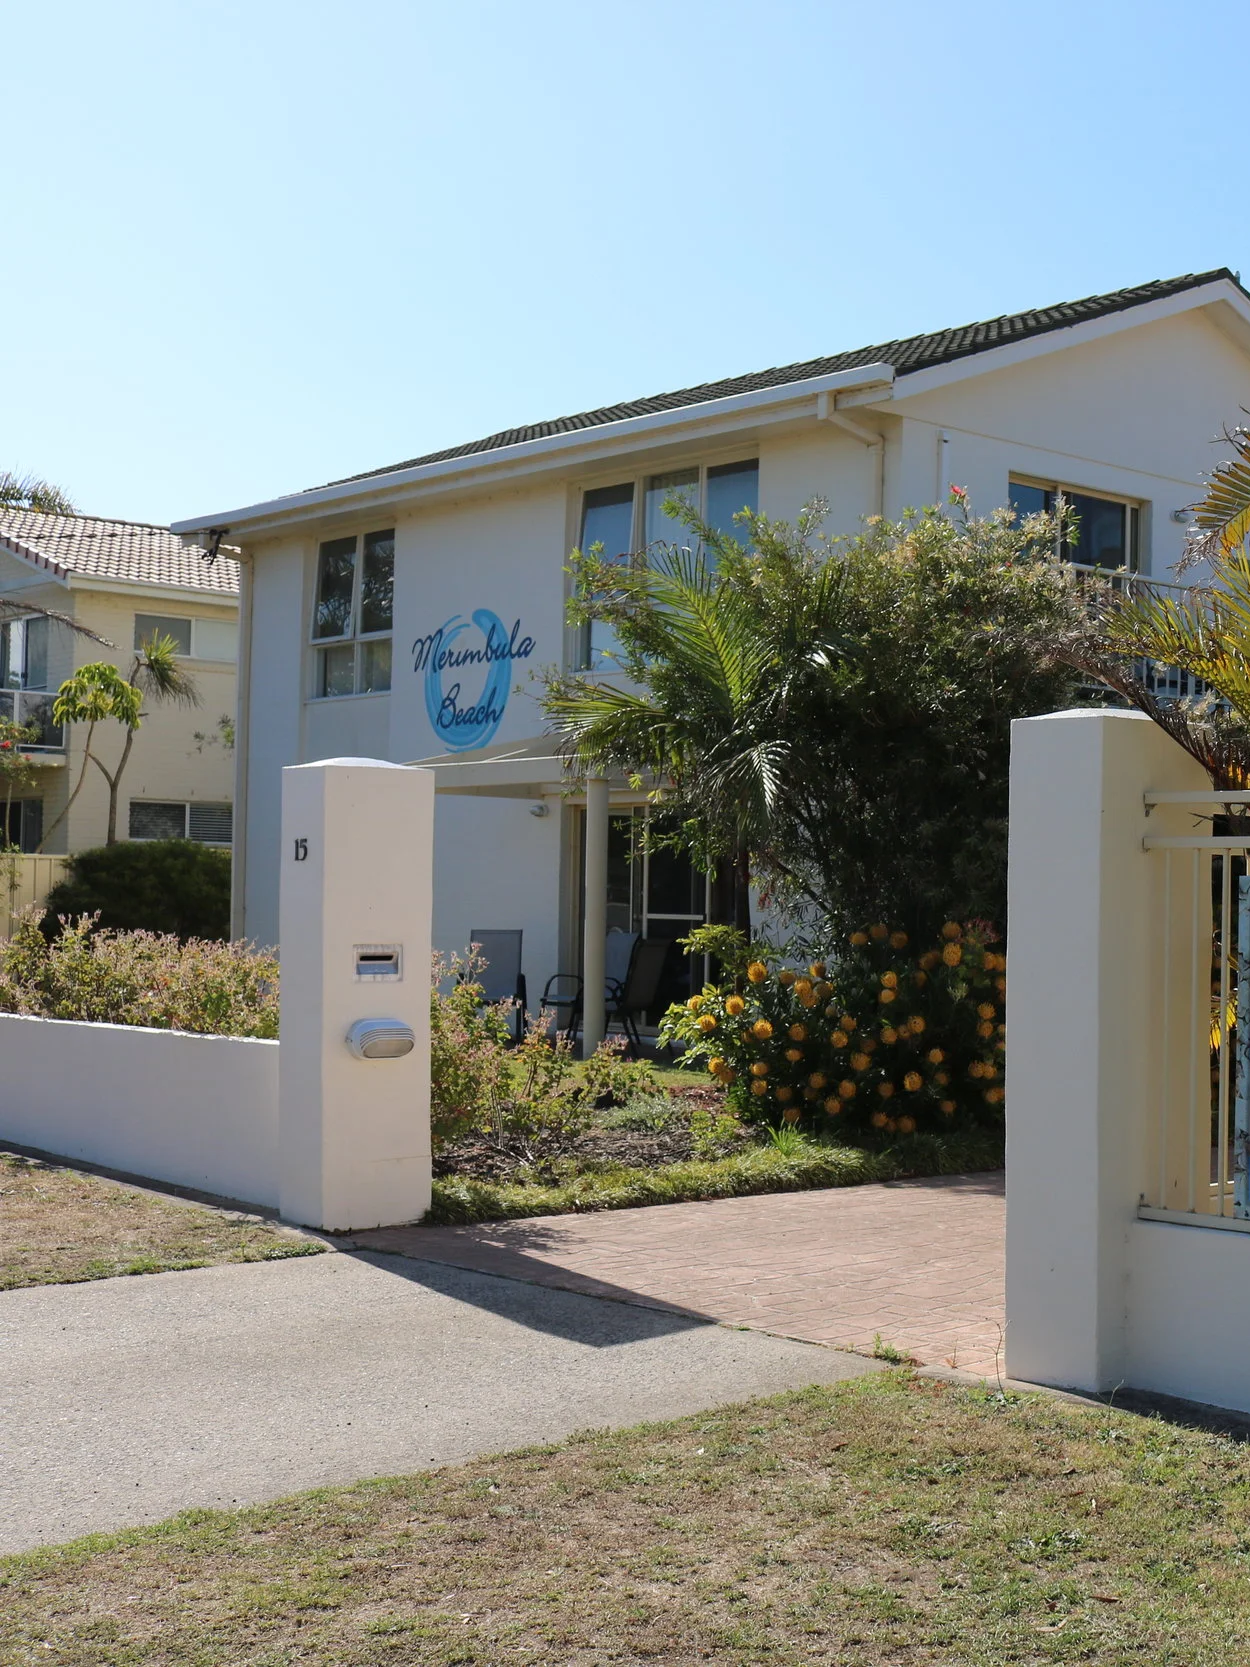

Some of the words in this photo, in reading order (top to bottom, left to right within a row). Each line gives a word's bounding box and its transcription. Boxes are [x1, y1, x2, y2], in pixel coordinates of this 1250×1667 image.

[412, 618, 536, 673] Merimbula
[437, 683, 505, 729] Beach
[295, 838, 308, 861] 15
